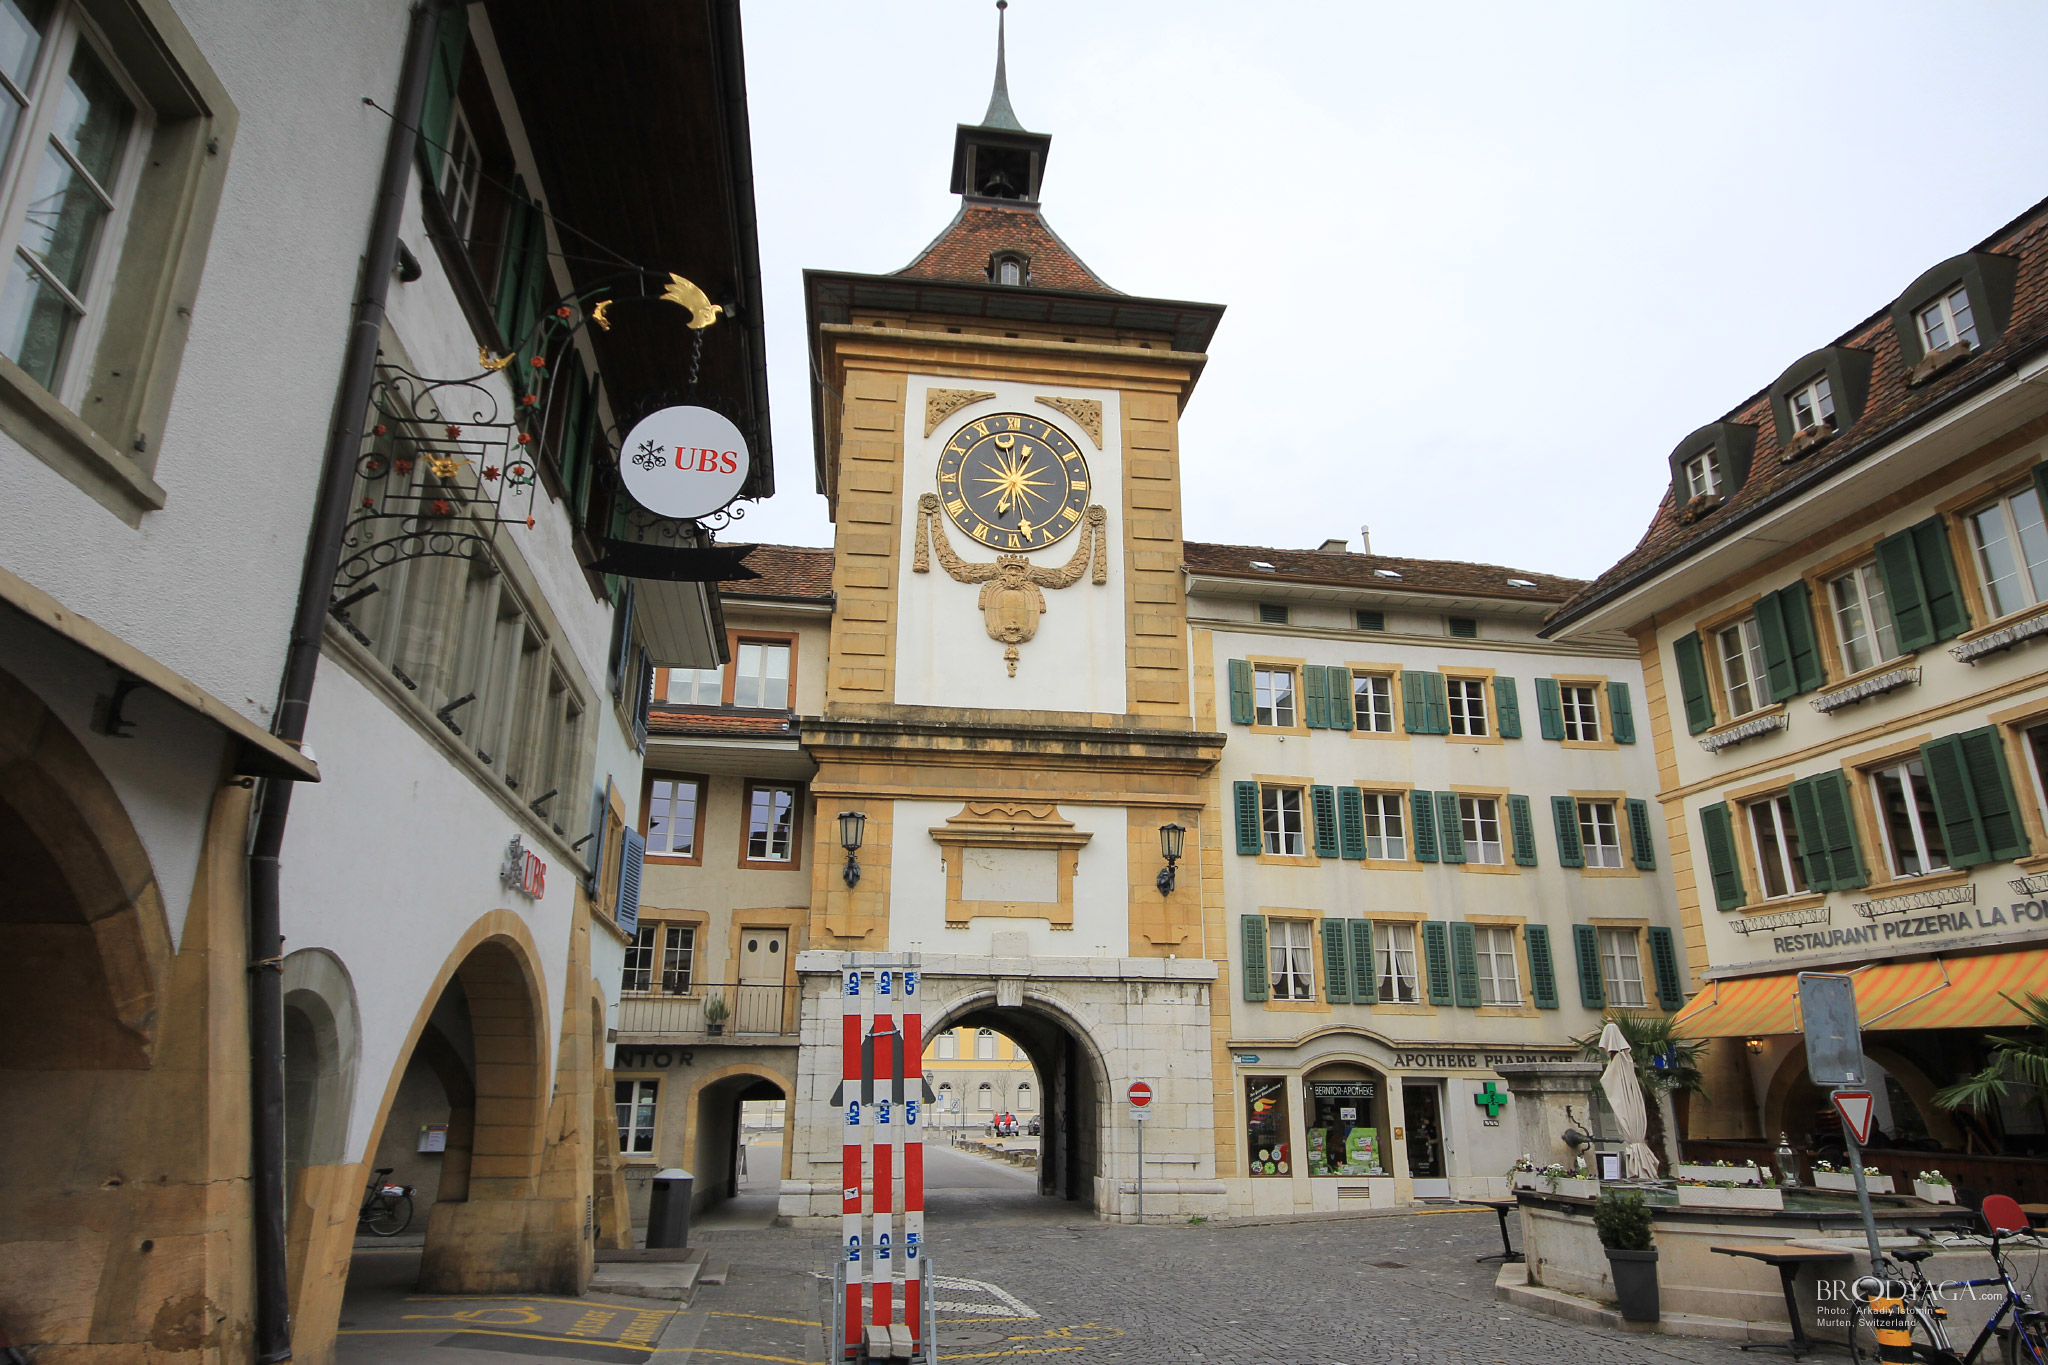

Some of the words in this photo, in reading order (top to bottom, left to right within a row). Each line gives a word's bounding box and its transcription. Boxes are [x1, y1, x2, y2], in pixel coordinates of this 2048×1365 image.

[973, 423, 990, 437] XI
[1007, 418, 1020, 430] XII
[949, 442, 967, 456] X
[1062, 450, 1078, 462] II
[674, 446, 738, 474] UBS
[941, 472, 957, 483] IX
[1071, 481, 1086, 490] III
[522, 848, 547, 900] UBS
[1773, 924, 1879, 953] RESTAURANT
[1883, 911, 1973, 940] PIZZERIA
[1975, 906, 2007, 928] LA
[1394, 1053, 1477, 1068] APOTHEKE
[1315, 1086, 1374, 1096] BERNTOR-APOTHEKE
